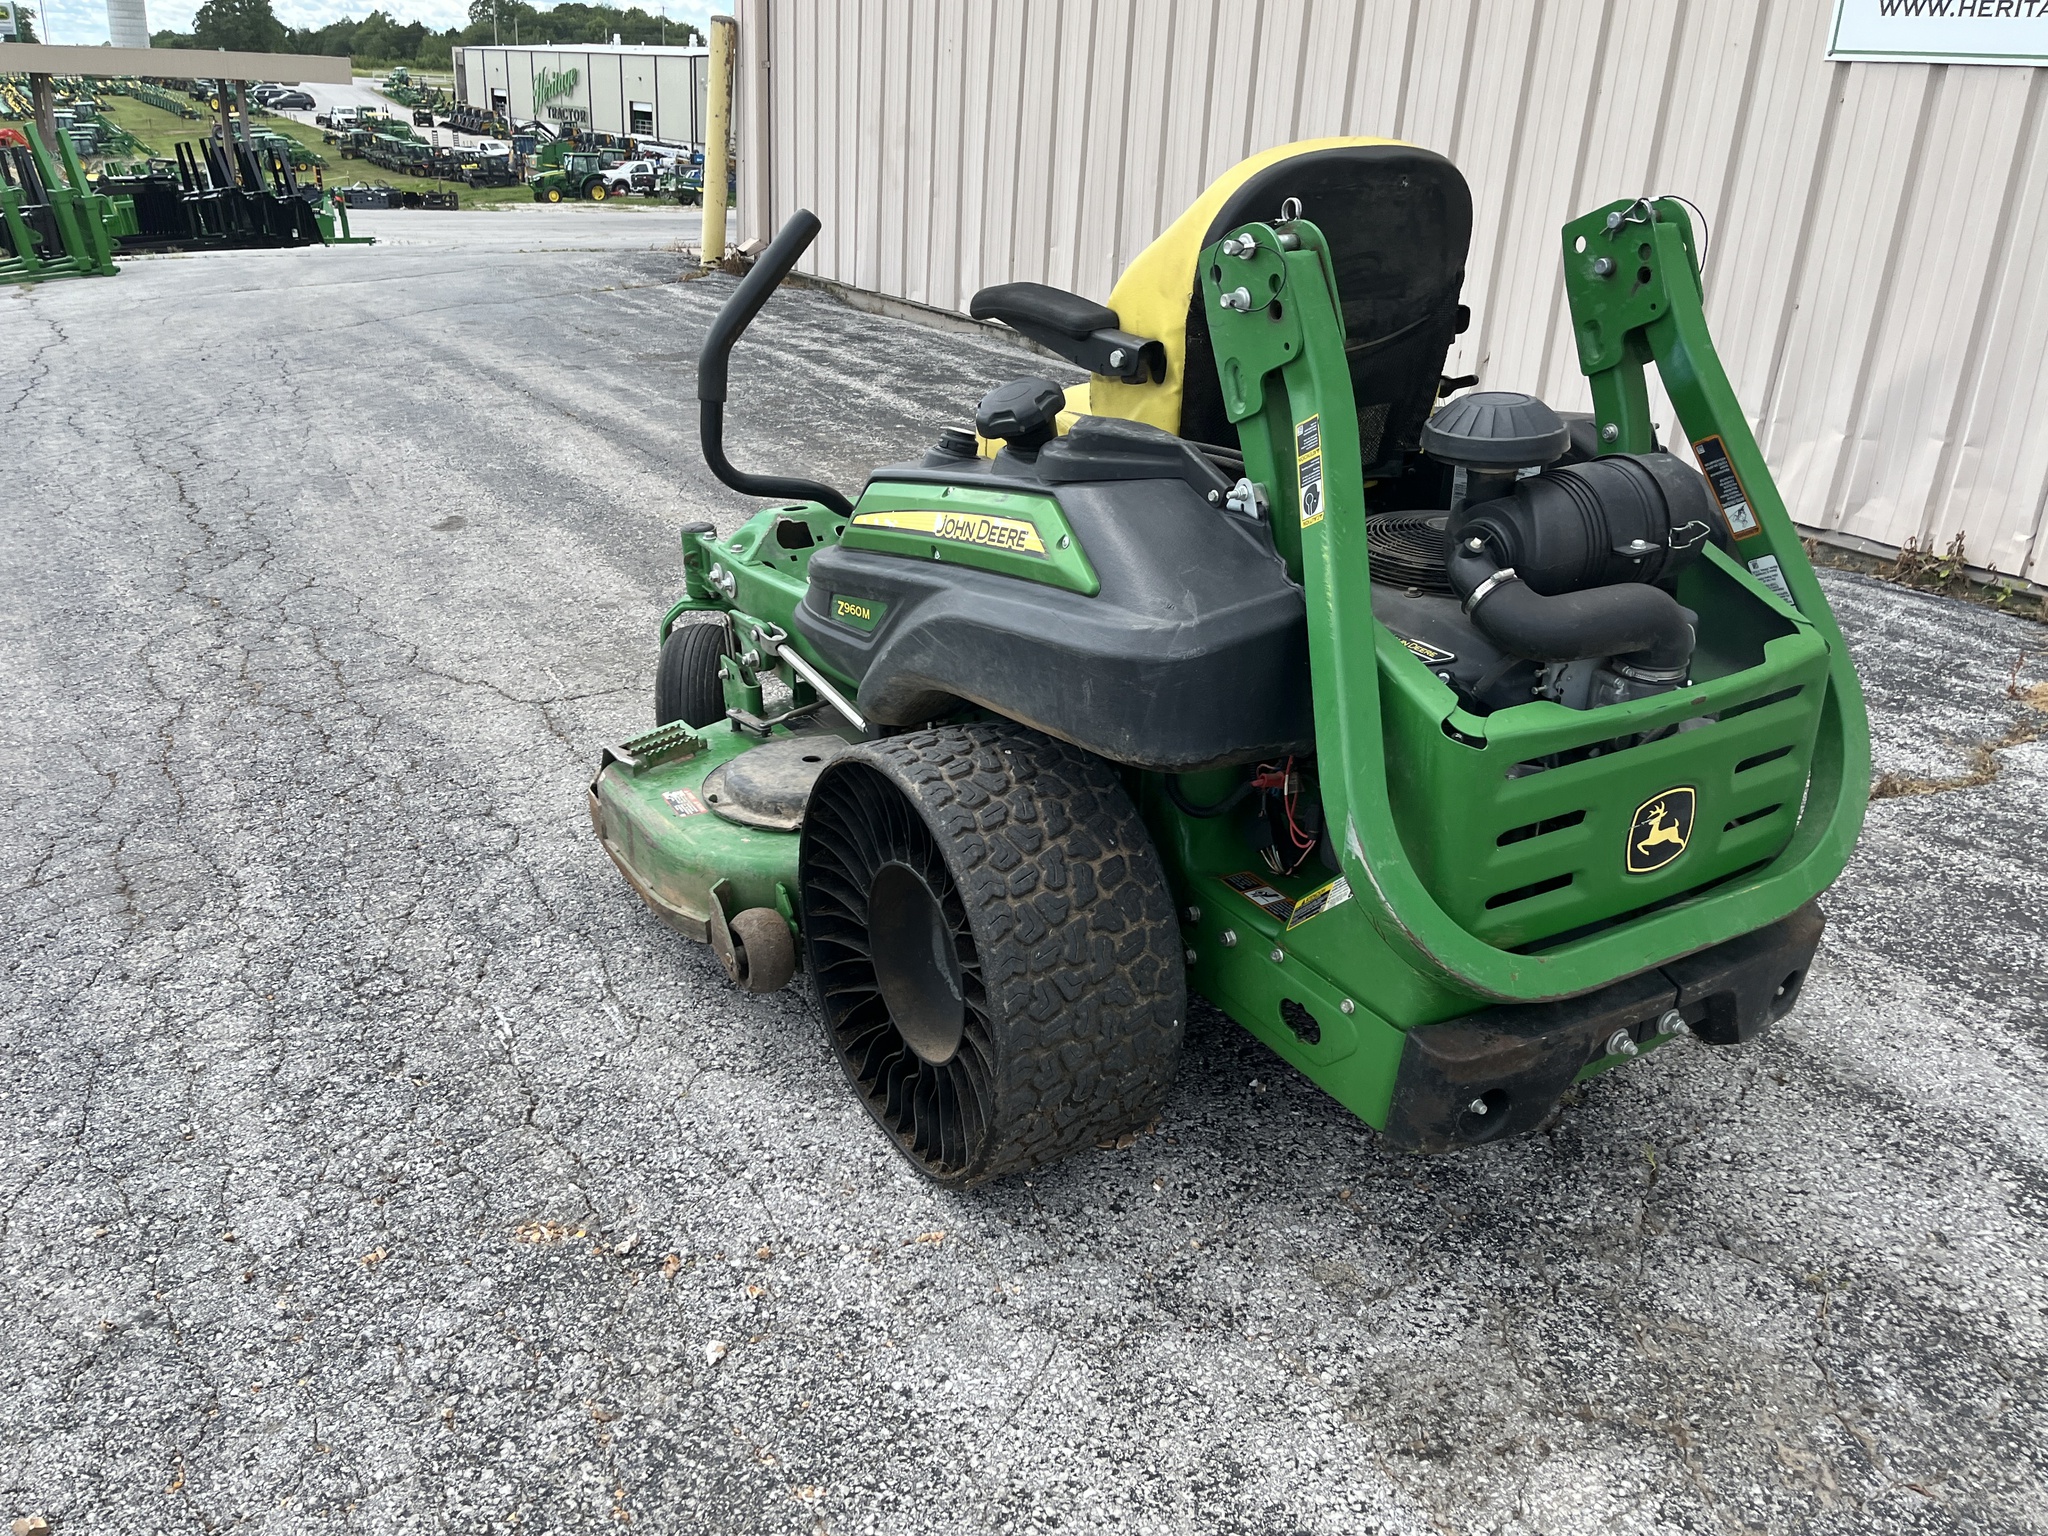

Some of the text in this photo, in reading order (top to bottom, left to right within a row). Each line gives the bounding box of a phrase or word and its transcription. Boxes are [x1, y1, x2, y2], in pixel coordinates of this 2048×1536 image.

[533, 66, 578, 115] Heritage
[546, 105, 587, 123] TRACTOR
[936, 514, 1028, 548] JOHN DEERE
[837, 600, 870, 620] Z960M
[1407, 642, 1438, 658] DEERE
